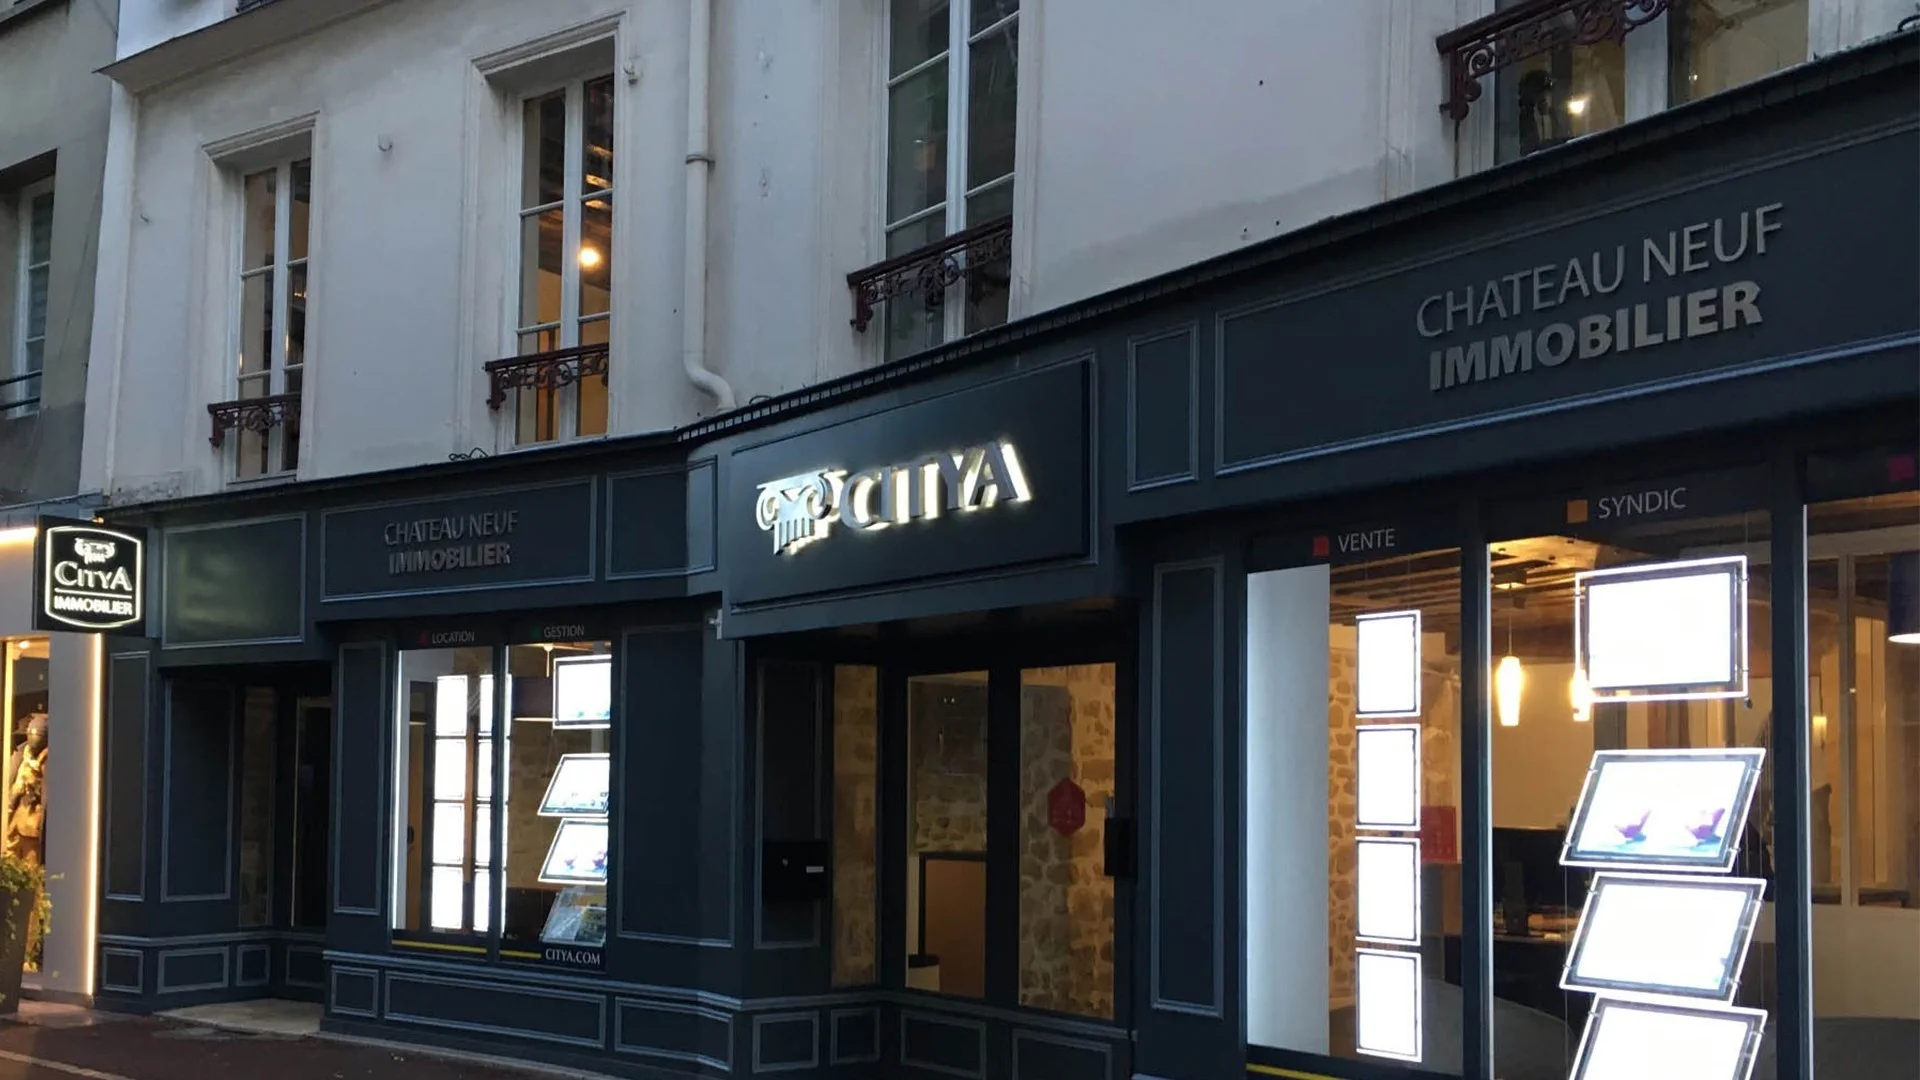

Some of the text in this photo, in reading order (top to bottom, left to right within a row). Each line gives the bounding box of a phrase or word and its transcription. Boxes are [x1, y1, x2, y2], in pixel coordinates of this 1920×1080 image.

[1416, 202, 1784, 338] CHATEAU NEUF
[1429, 280, 1764, 392] IMMOBILIER
[840, 441, 1031, 531] CITYA
[1598, 486, 1687, 519] SYNDIC
[384, 509, 518, 546] CHATEAU NEUF
[1337, 528, 1395, 553] VENTE
[388, 542, 511, 575] IMMOBILIER
[54, 595, 132, 616] IMMOBILIER
[431, 631, 475, 645] LOCATION
[543, 624, 585, 639] GESTION
[545, 948, 601, 966] CITYA.COM
